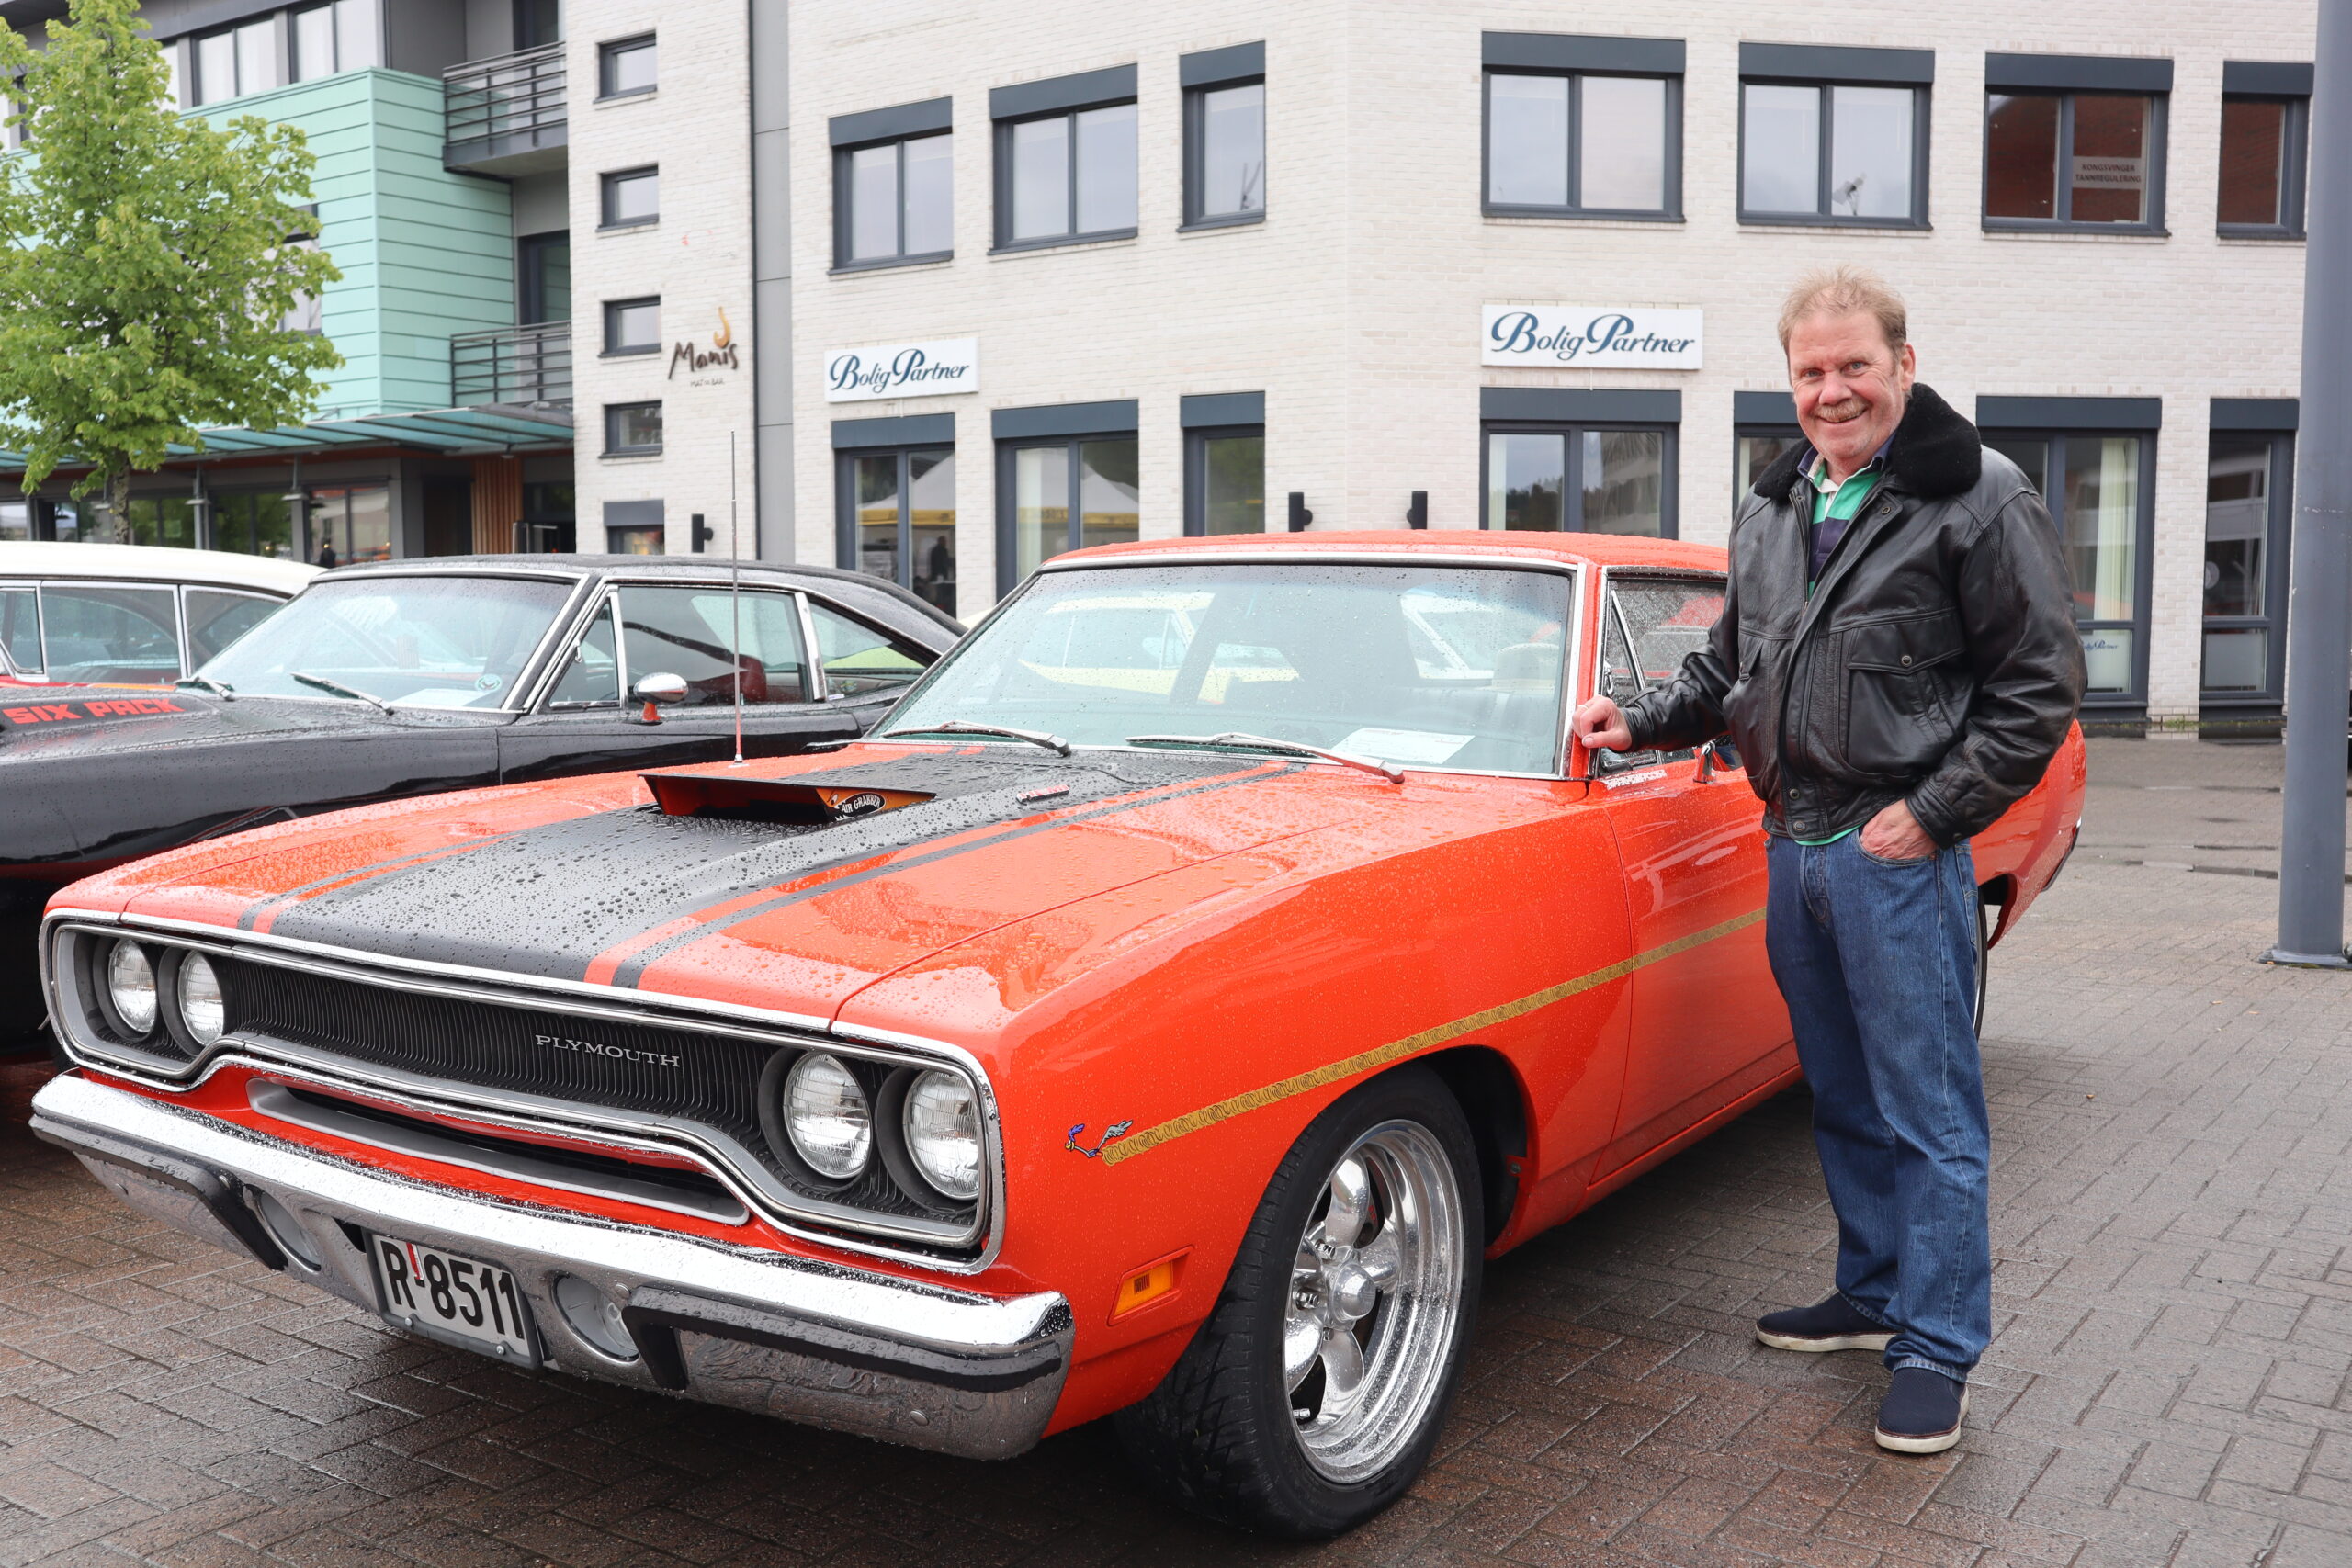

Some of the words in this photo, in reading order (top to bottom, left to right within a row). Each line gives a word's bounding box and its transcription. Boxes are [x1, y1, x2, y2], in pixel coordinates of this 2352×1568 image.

[2081, 163, 2135, 173] KONGSVINGER
[2075, 174, 2142, 183] TANNREGULERING
[2, 704, 83, 724] SIX
[84, 697, 187, 717] PACK
[841, 803, 853, 813] AIR
[854, 794, 881, 809] GRABBER
[535, 1034, 681, 1067] PLYMOUTH
